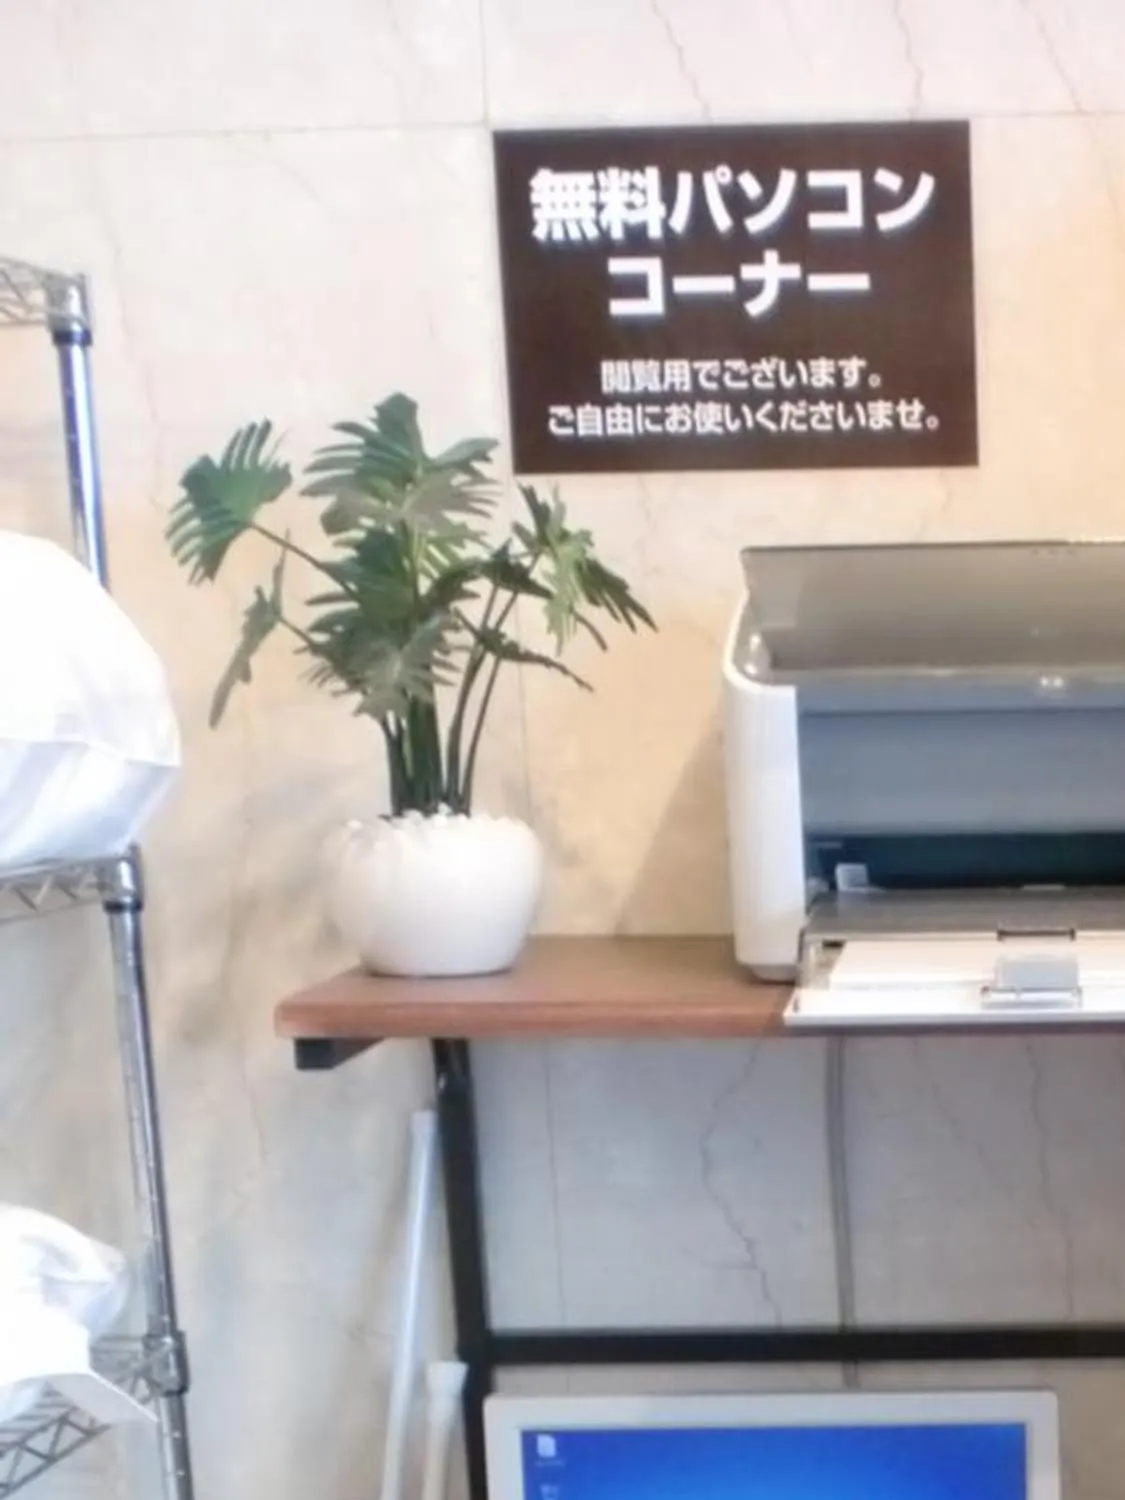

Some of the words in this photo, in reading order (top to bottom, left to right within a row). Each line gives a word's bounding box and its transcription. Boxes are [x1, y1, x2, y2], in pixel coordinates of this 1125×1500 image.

[529, 164, 935, 241] 無料パソコン
[607, 249, 871, 318] コーナー
[600, 355, 881, 394] 閲覧用でございます。
[547, 397, 940, 437] ご自由にお使いくださいませ。
